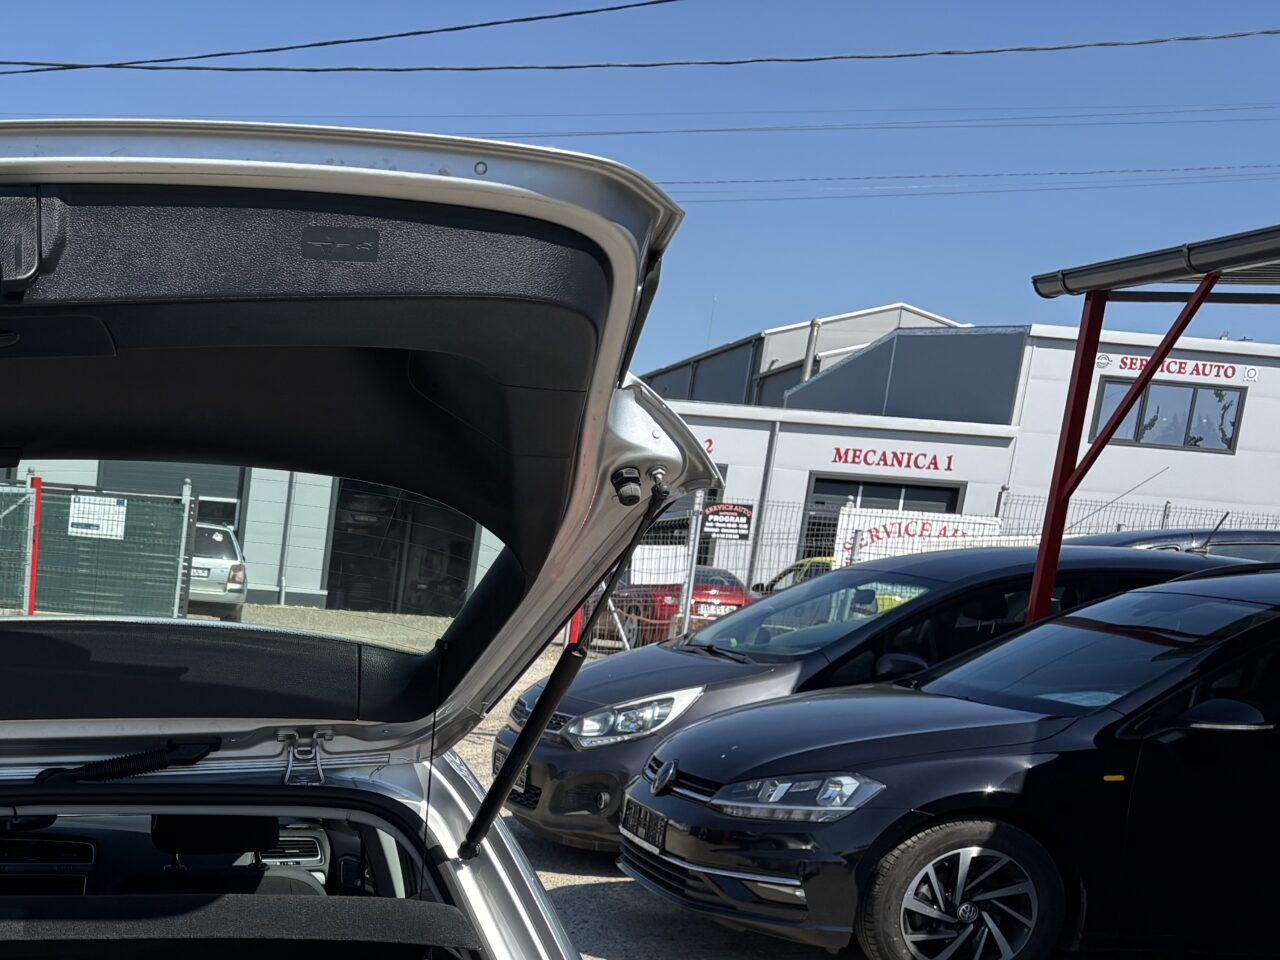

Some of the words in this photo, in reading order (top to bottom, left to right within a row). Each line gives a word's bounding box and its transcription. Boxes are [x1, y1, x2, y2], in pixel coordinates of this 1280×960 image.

[1119, 356, 1188, 375] SERICE
[1189, 362, 1237, 379] AUTO
[832, 447, 939, 471] MECANICA
[944, 455, 953, 471] 1
[708, 515, 747, 523] PROGRAM
